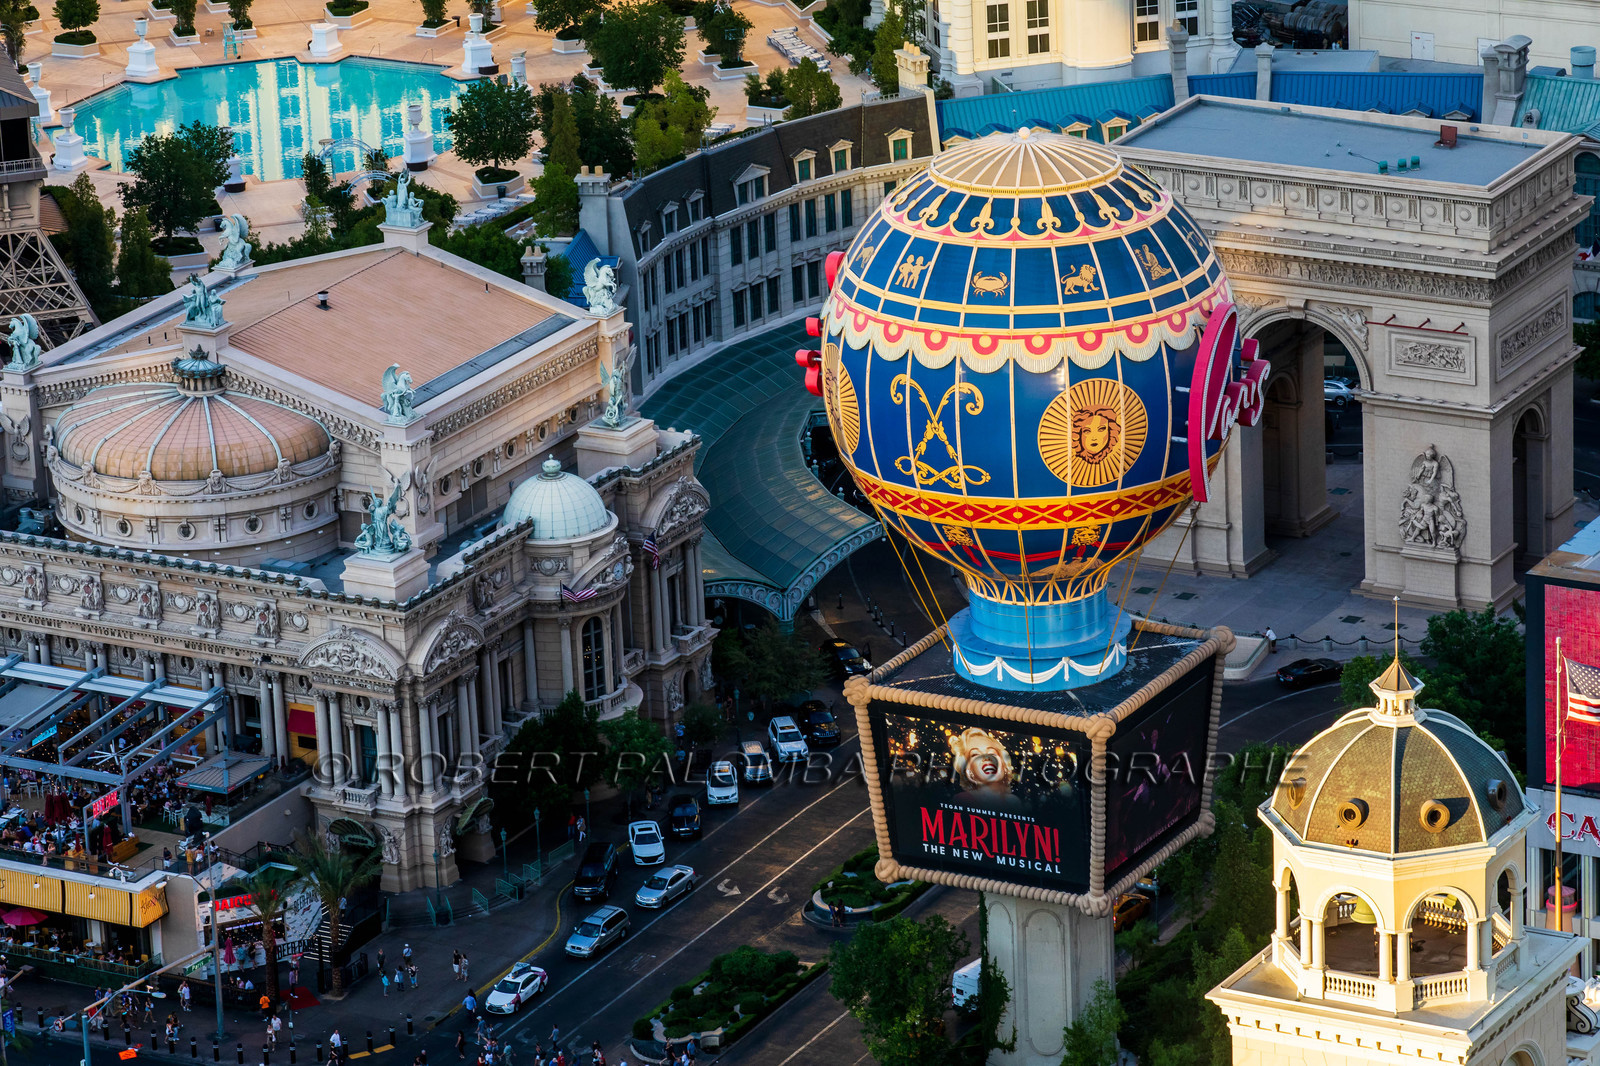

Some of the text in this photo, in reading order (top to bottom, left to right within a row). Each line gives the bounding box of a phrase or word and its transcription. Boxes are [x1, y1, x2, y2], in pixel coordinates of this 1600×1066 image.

[15, 616, 226, 655] ACADEMIE NATIONALE DE MUSIQUE
[940, 802, 1035, 822] TEGAN SUMMER PRESENTS
[920, 806, 1060, 863] MARILYN!
[923, 843, 1061, 874] THE NEW MUSICAL
